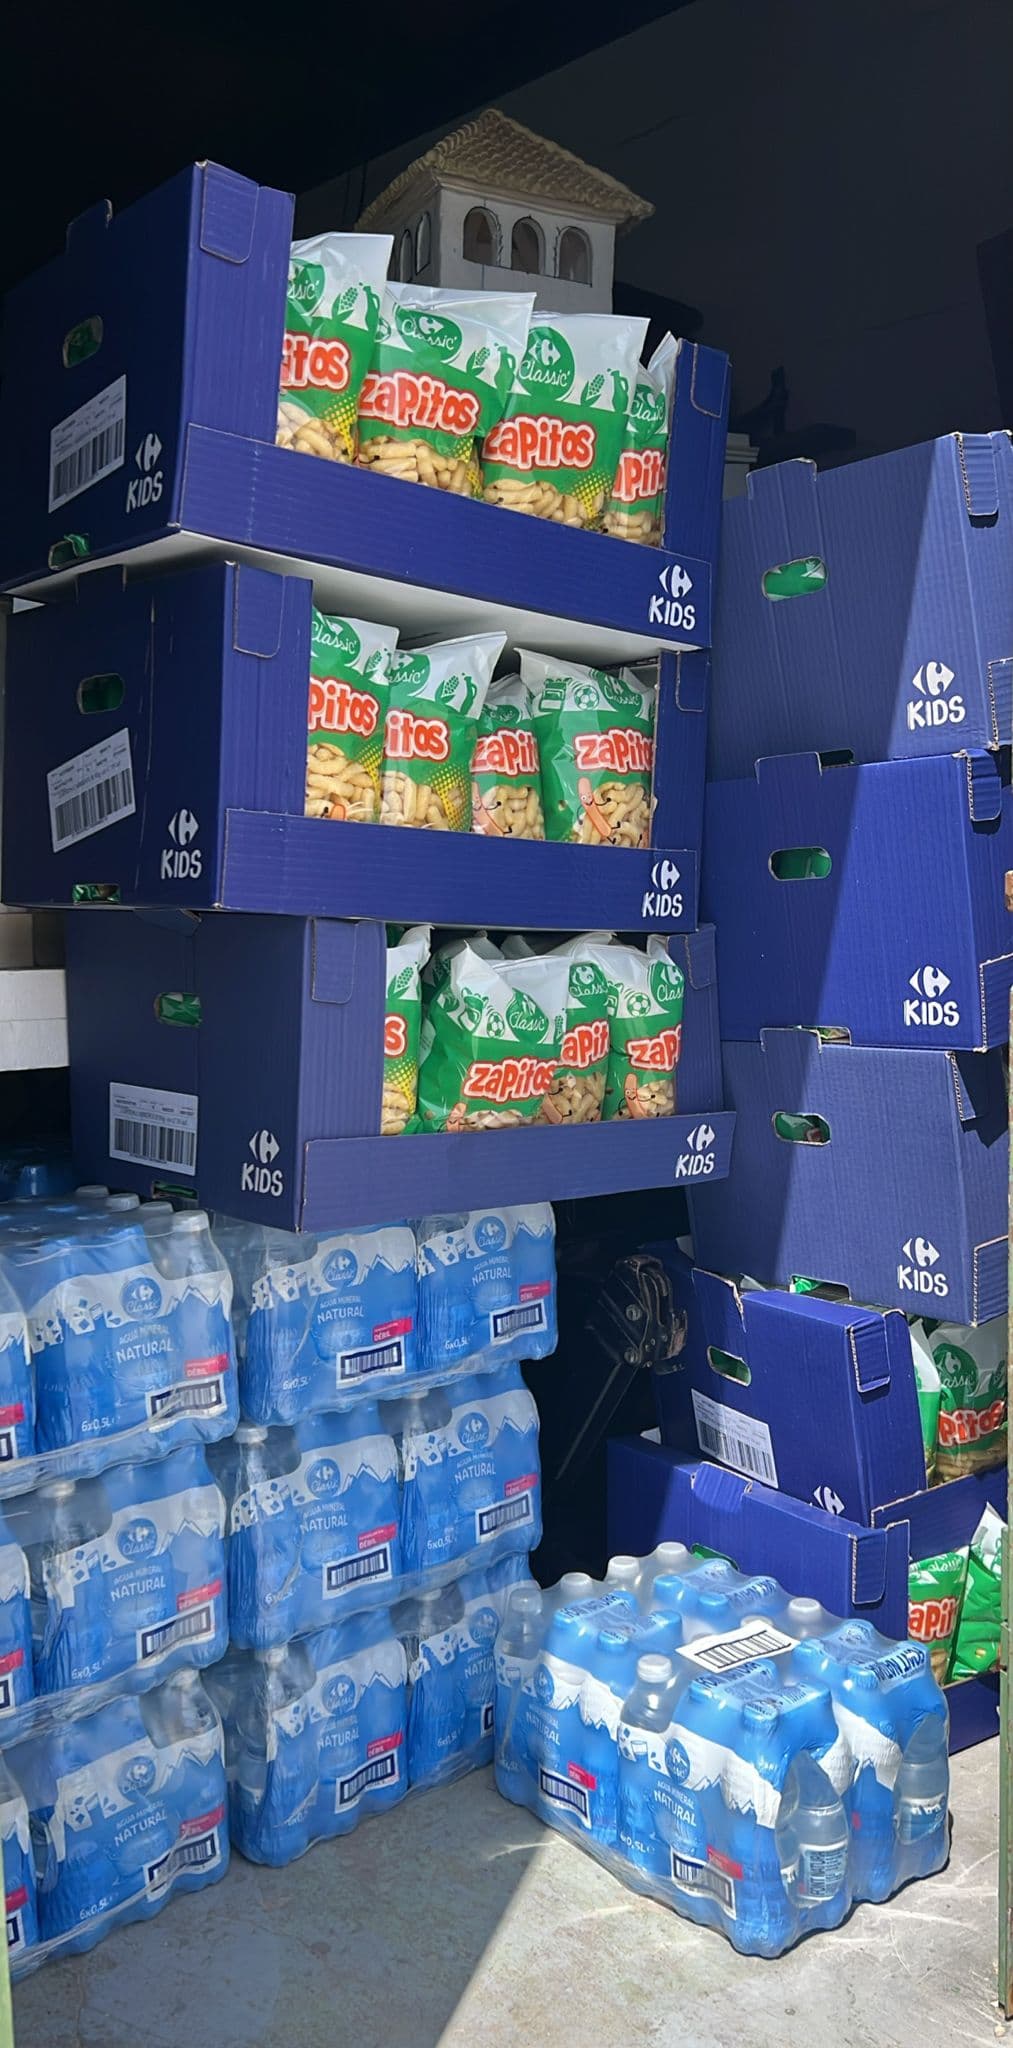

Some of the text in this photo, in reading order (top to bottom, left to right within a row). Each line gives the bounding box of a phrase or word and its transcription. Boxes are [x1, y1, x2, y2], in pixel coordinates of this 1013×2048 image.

[401, 317, 457, 350] Classic
[519, 360, 571, 388] Classic
[126, 471, 163, 513] KIDS
[649, 594, 696, 630] KIDS
[907, 696, 965, 731] KIDS
[161, 849, 202, 880] KIDS
[642, 893, 683, 918] KIDS
[903, 999, 960, 1027] KIDS
[241, 1163, 283, 1196] KIDS
[676, 1153, 715, 1178] KIDS
[471, 1266, 513, 1286] NATURAL
[897, 1264, 949, 1297] KIDS
[317, 1305, 365, 1325] NATURAL
[115, 1337, 174, 1363] NATURAL
[454, 1461, 497, 1485] NATURAL
[299, 1514, 349, 1535] NATURAL
[110, 1575, 167, 1602] NATURAL
[316, 1727, 360, 1750] NATURAL
[525, 1711, 560, 1745] NATURAL
[653, 1789, 697, 1828] NATURAL
[114, 1809, 169, 1846] NATURAL
